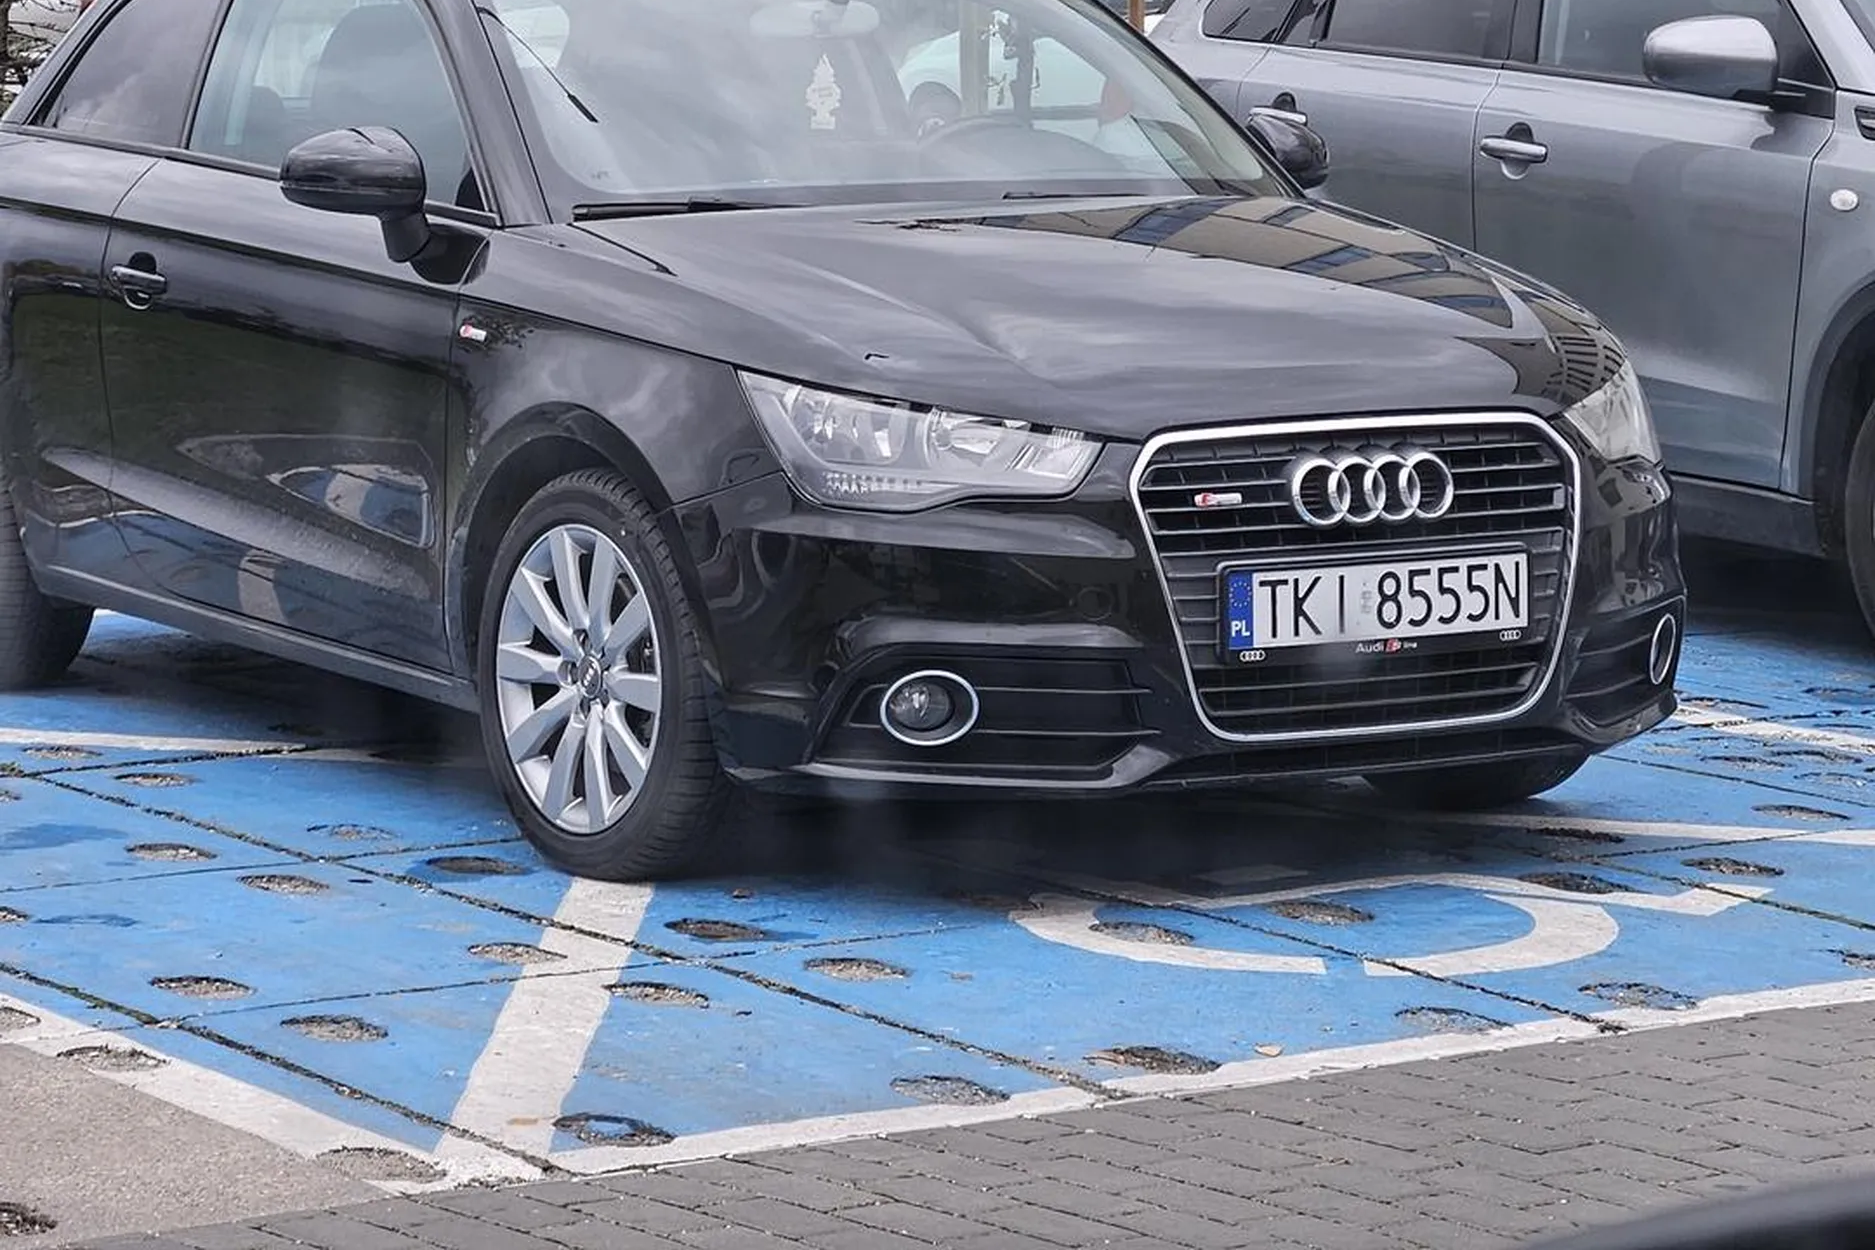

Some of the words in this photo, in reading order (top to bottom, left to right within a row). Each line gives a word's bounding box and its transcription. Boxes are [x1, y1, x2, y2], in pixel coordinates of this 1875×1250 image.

[1258, 574, 1345, 639] TKI
[1376, 560, 1521, 630] 8555N
[1231, 619, 1251, 637] PL
[1355, 640, 1384, 654] Audi
